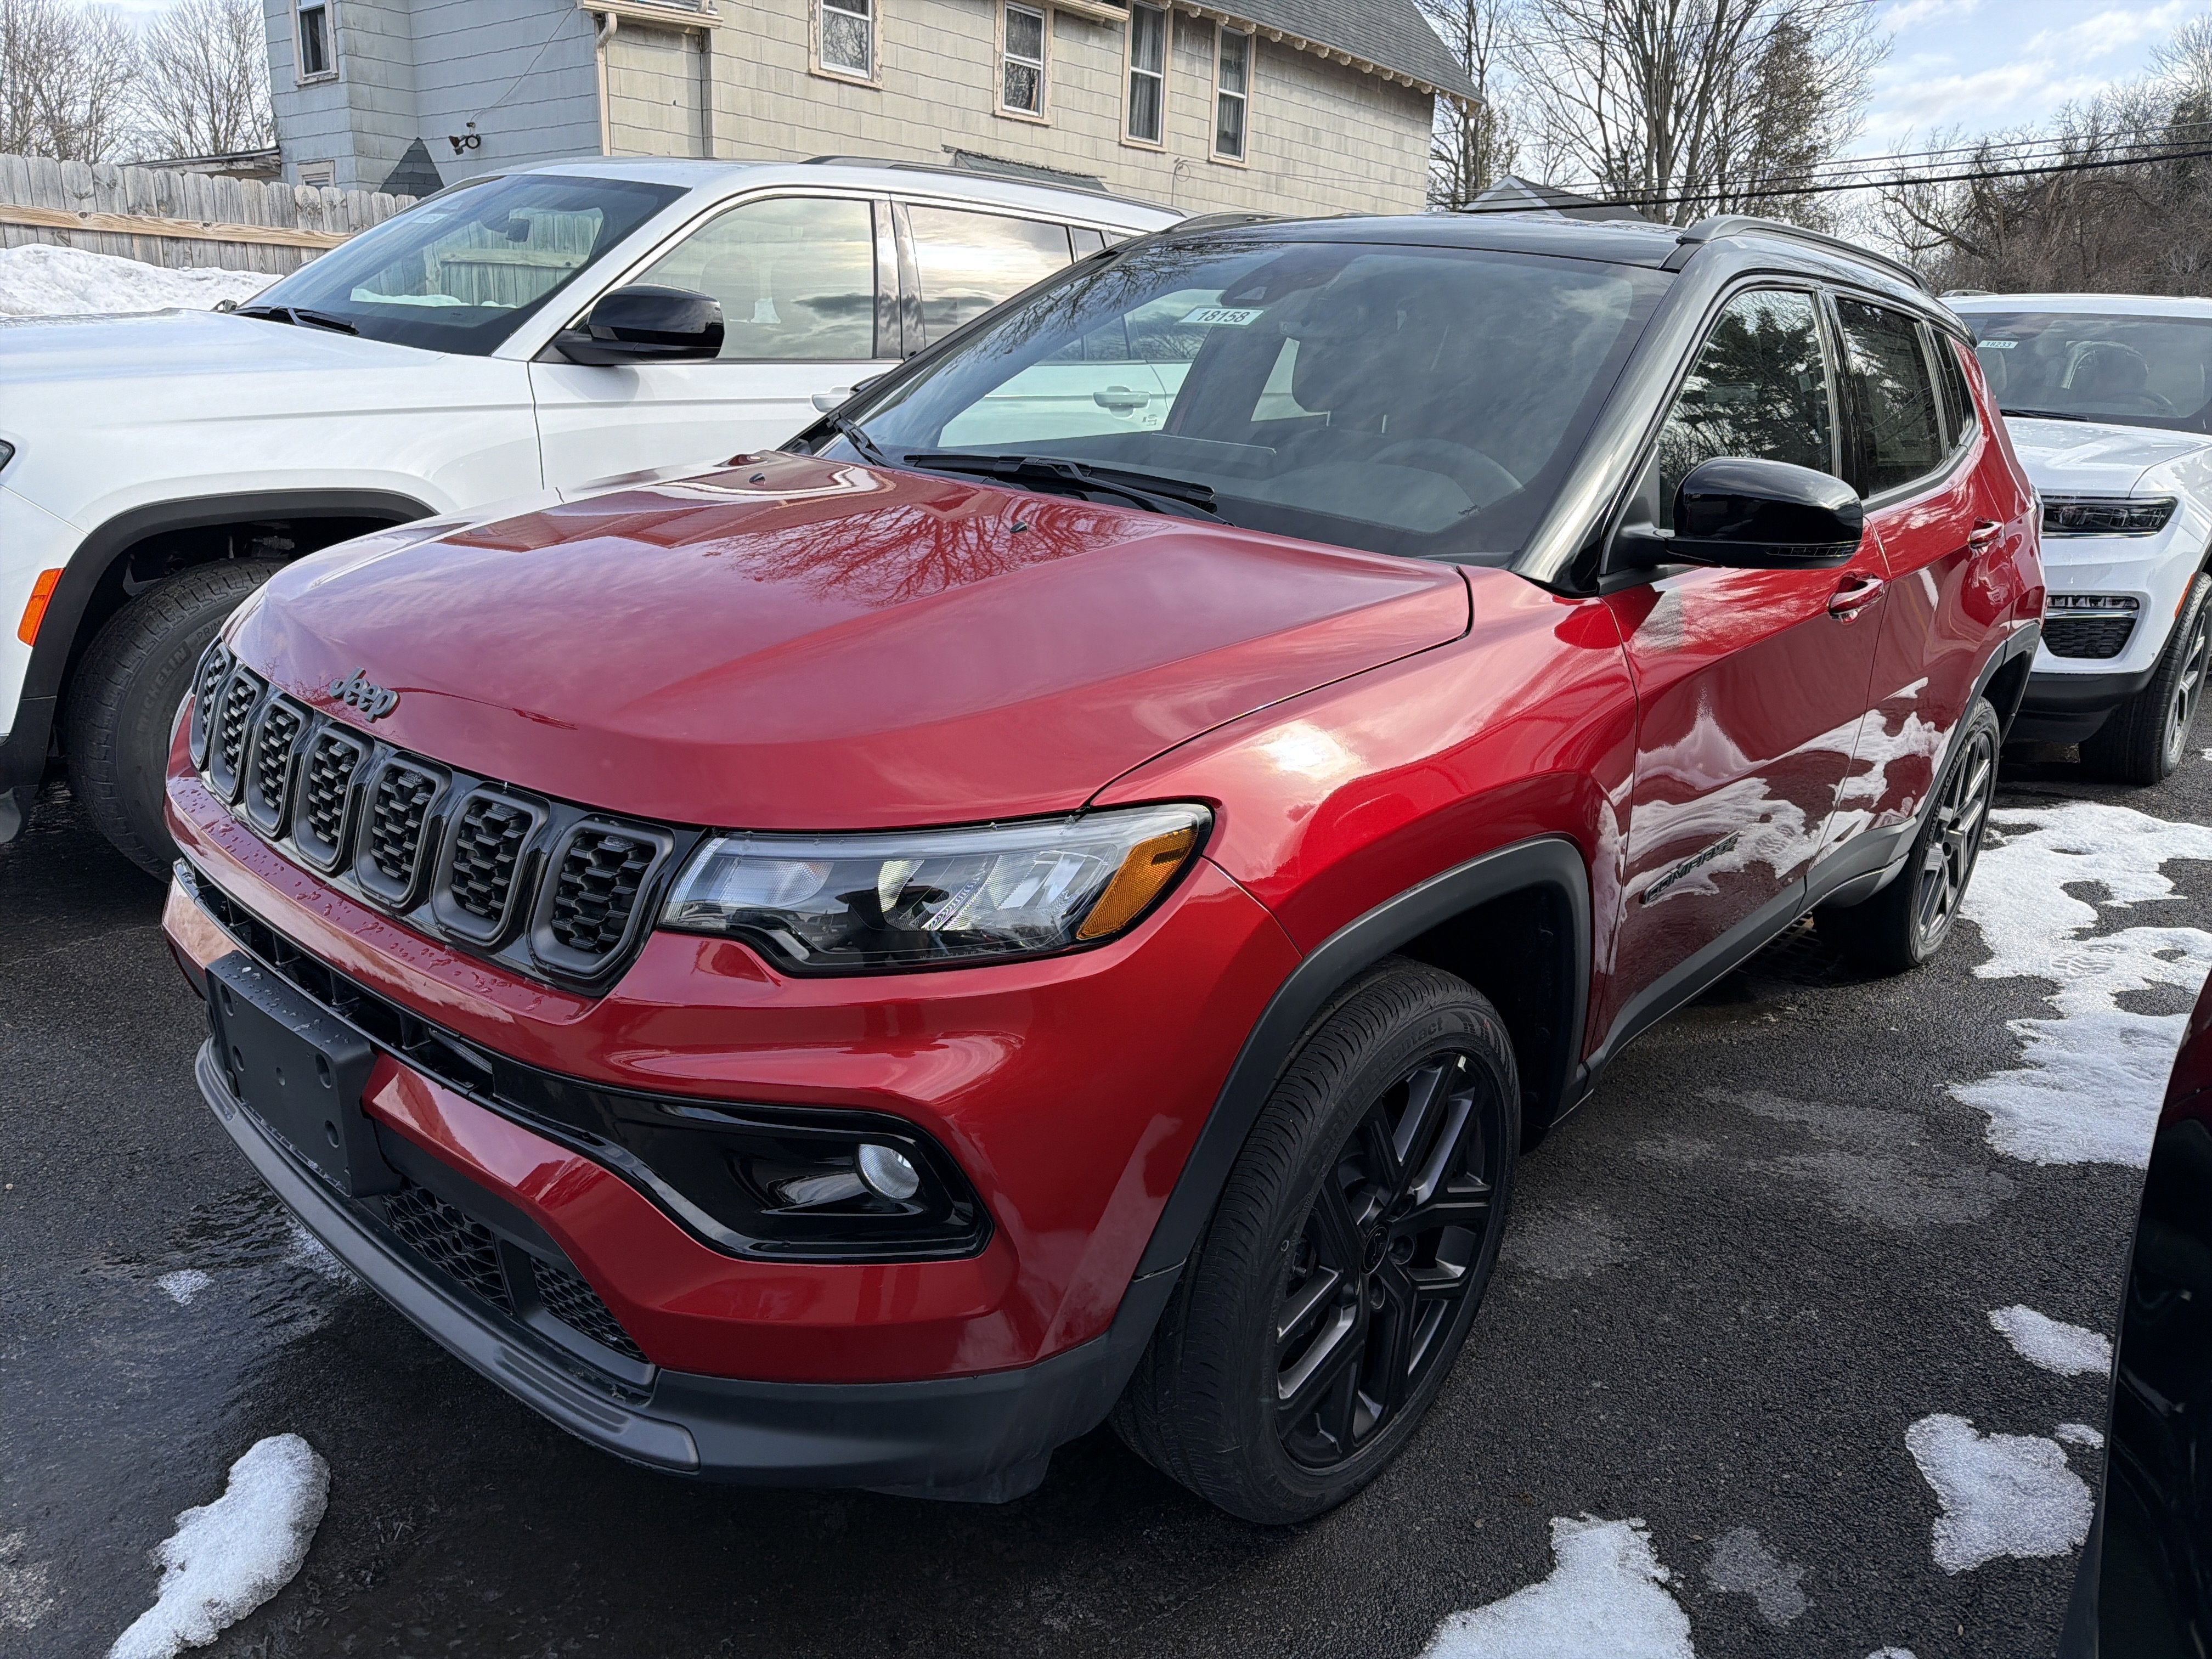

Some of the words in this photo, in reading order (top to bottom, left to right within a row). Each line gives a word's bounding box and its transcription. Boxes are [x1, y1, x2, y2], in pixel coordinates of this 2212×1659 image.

[1197, 310, 1251, 323] 18158
[137, 646, 188, 732] MICHELIN
[196, 619, 222, 641] PRIM
[329, 667, 400, 723] Jeep
[1643, 830, 1740, 904] COMPASS
